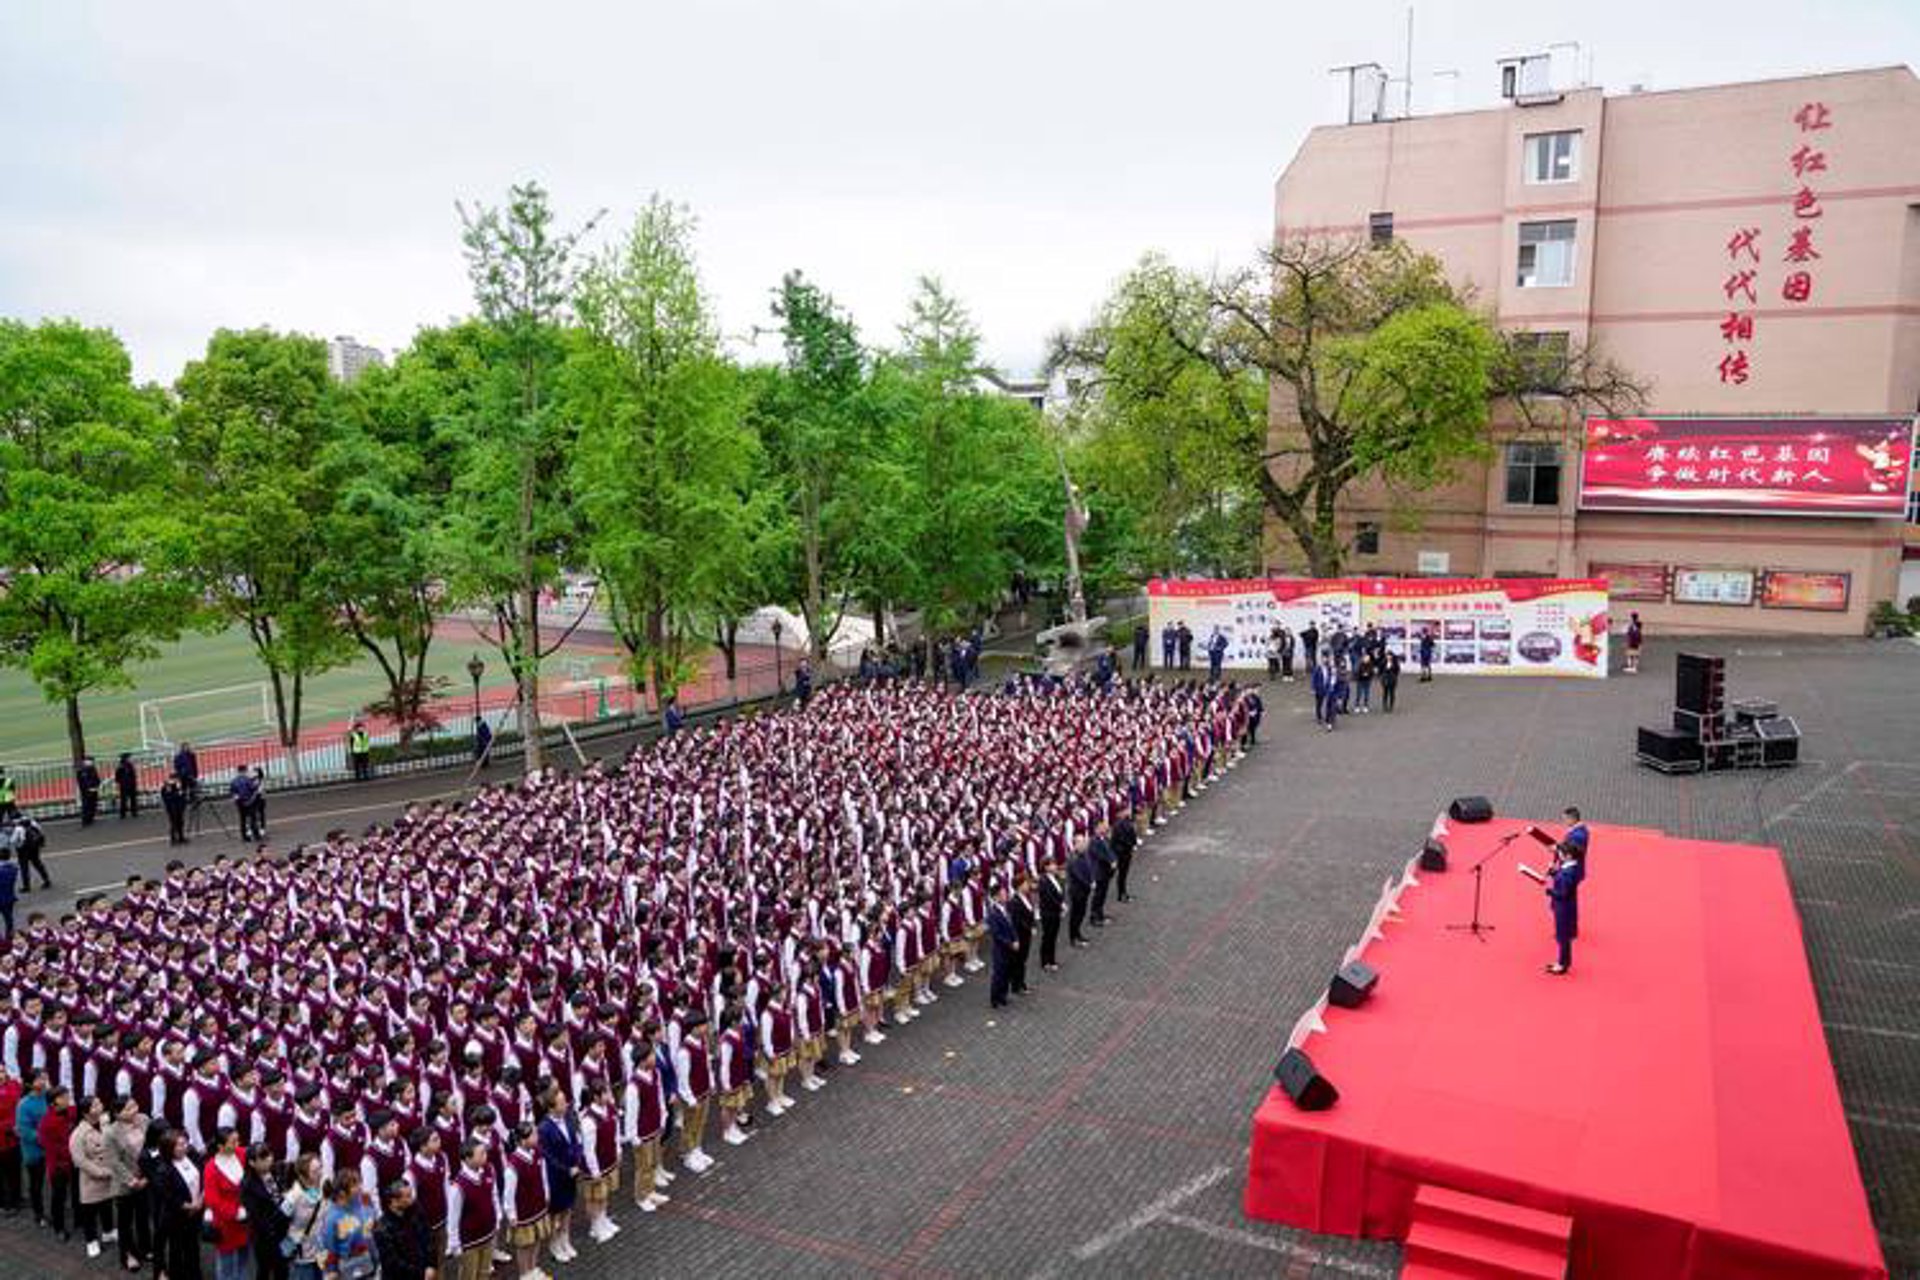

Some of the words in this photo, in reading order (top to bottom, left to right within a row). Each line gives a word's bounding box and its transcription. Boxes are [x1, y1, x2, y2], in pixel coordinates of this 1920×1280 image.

[1783, 102, 1832, 302] 让红色基因
[1718, 227, 1761, 385] 代代相传
[1645, 465, 1833, 484] 争做时代新人
